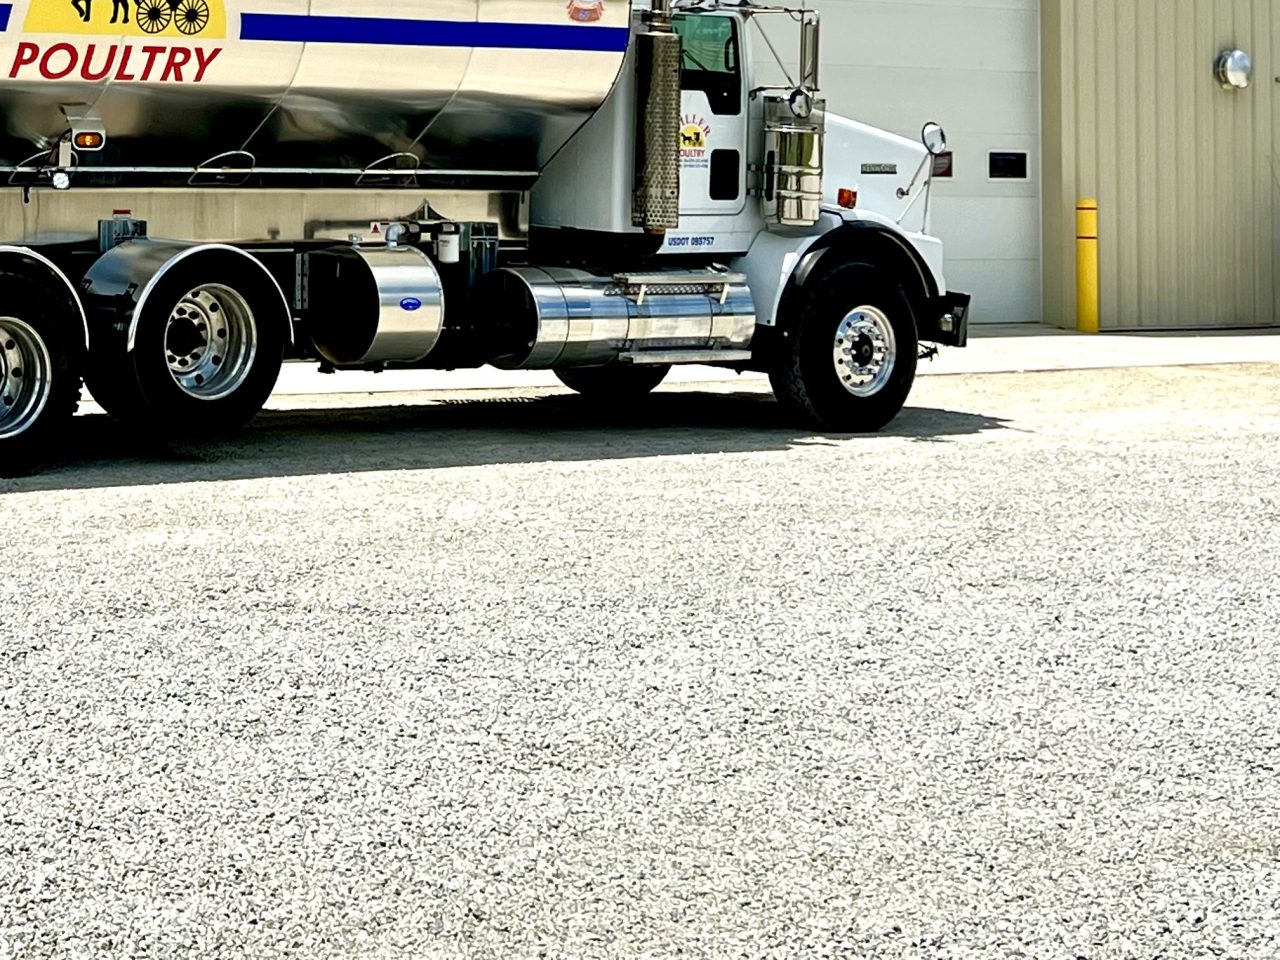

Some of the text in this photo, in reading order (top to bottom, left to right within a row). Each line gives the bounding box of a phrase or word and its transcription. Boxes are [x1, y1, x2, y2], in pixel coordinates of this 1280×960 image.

[8, 41, 224, 83] POULTRY
[680, 113, 711, 137] ILLER
[677, 149, 706, 158] OULTRY
[668, 236, 690, 246] USDOT
